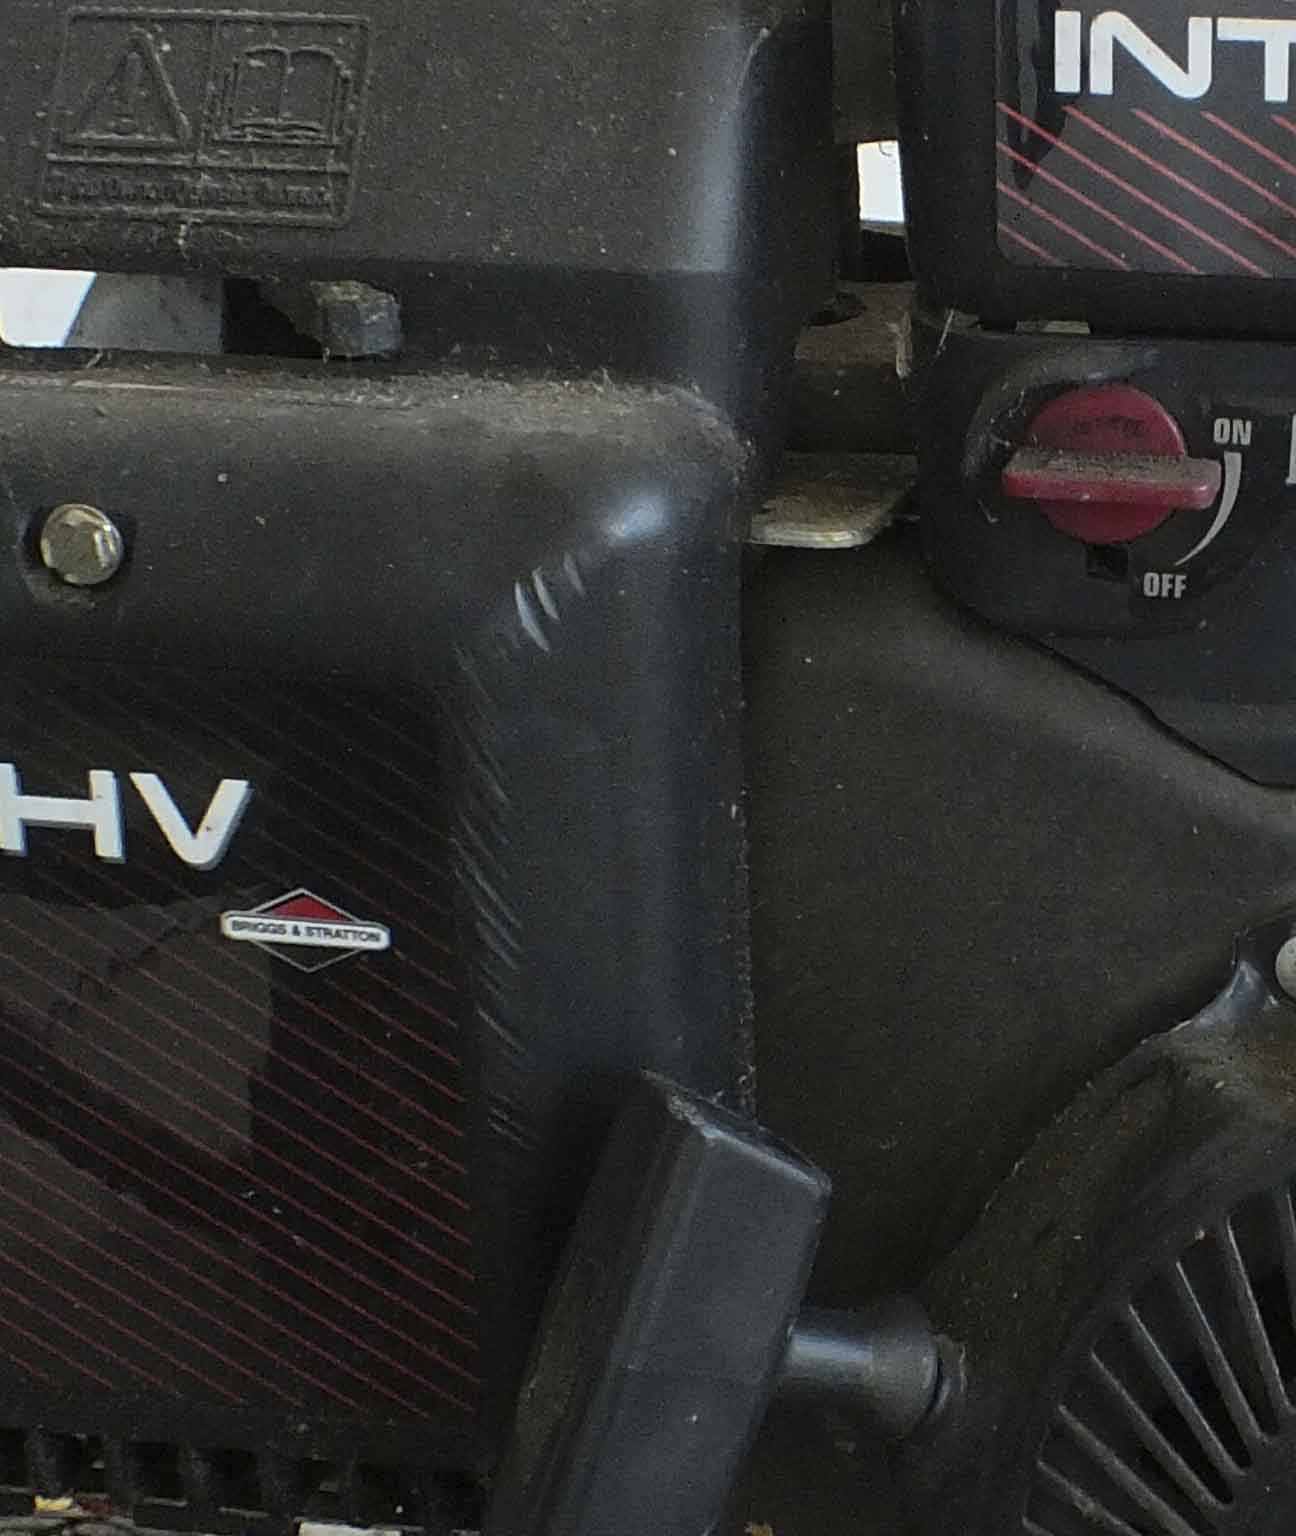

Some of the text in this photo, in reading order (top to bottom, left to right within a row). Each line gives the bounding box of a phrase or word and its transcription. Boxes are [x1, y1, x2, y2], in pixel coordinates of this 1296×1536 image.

[1213, 416, 1253, 448] ON
[1143, 571, 1188, 600] OFF
[231, 918, 381, 943] BRIGGS & STRATTON
